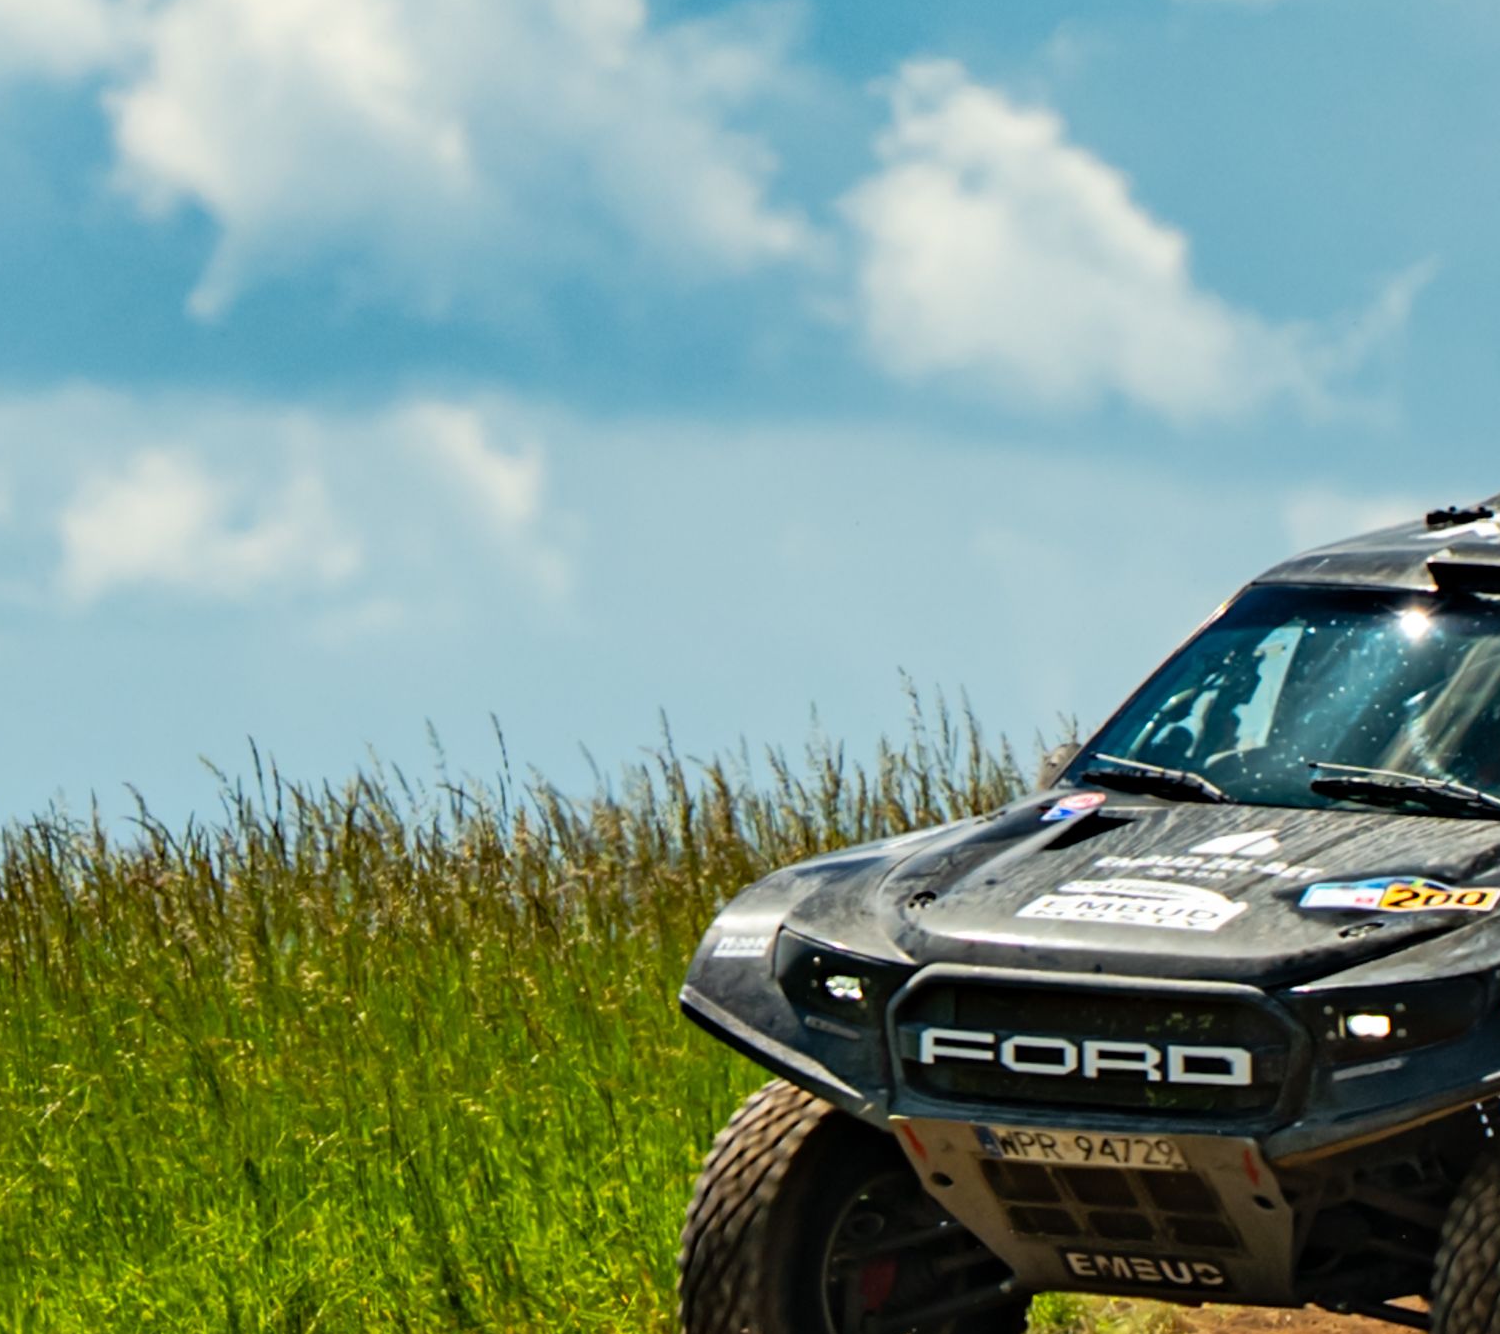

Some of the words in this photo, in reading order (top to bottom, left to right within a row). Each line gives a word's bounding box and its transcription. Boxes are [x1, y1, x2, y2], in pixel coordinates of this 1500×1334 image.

[1043, 899, 1220, 920] EMBUD
[1386, 888, 1489, 909] 200
[1033, 910, 1206, 927] MOSTY
[919, 1027, 1253, 1086] FORD
[999, 1129, 1064, 1161] WPR
[1074, 1134, 1177, 1166] 94729
[1064, 1252, 1225, 1286] EMBUD
